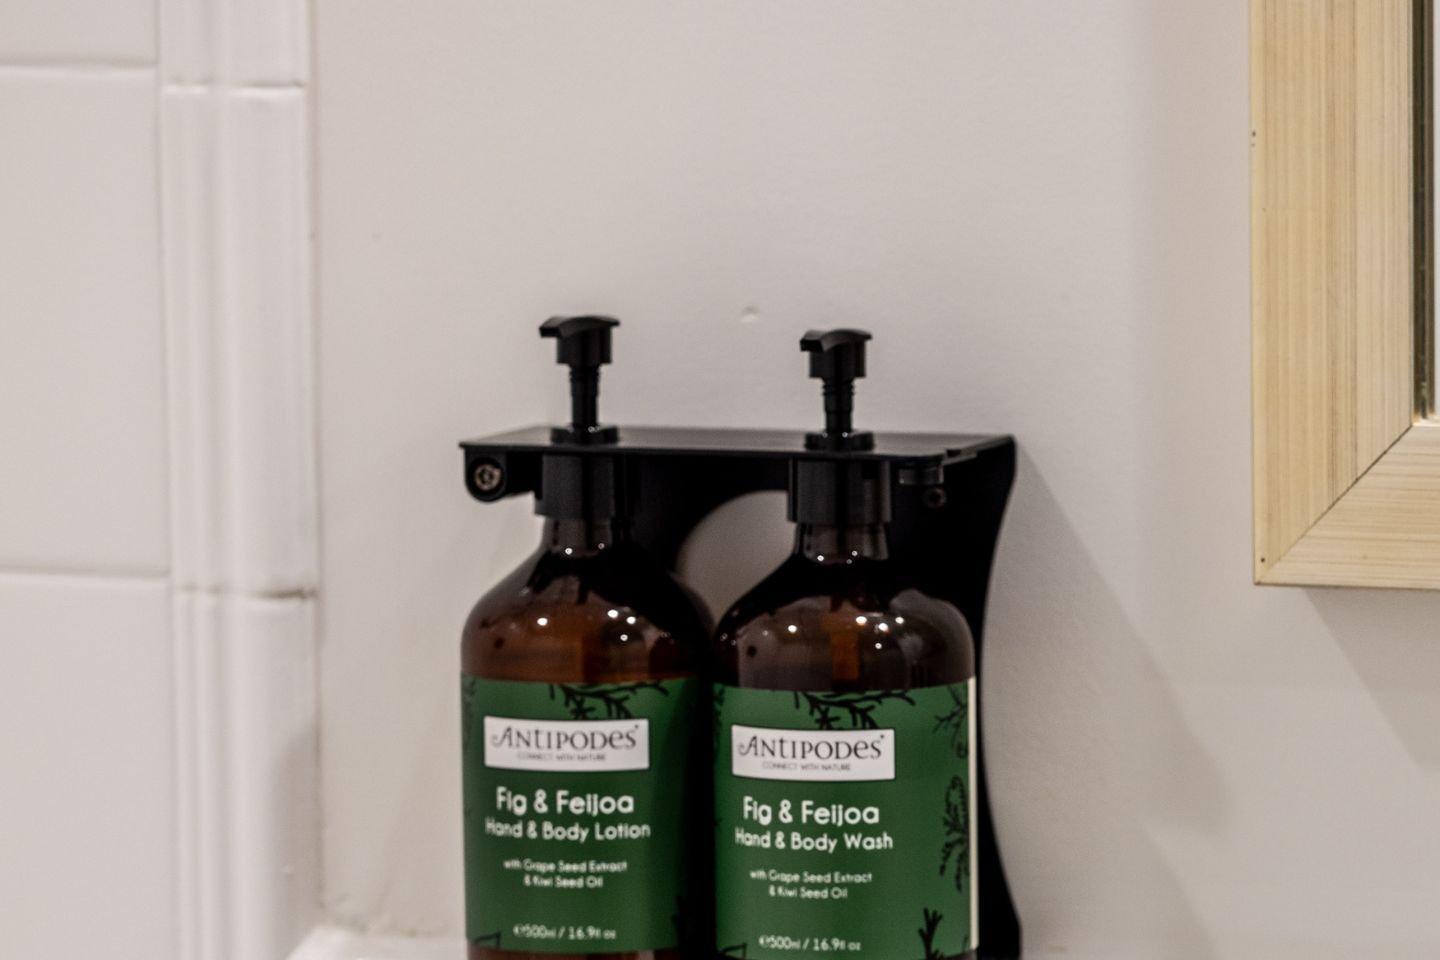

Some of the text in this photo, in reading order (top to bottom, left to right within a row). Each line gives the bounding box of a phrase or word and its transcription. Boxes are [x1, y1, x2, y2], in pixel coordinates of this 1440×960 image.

[496, 786, 634, 816] Fig & Feijoa
[743, 796, 879, 826] Fig & Feijoa
[485, 817, 651, 843] Hand & Body Lotion
[735, 827, 893, 853] Hand & Body Wash
[522, 858, 556, 873] Grape
[558, 859, 587, 873] Seed
[588, 860, 627, 873] Extract
[555, 875, 584, 888] Seed
[586, 875, 603, 888] Oil
[750, 869, 872, 884] with Grape Seed Extract
[769, 884, 848, 899] & Kiwi Seed Oil
